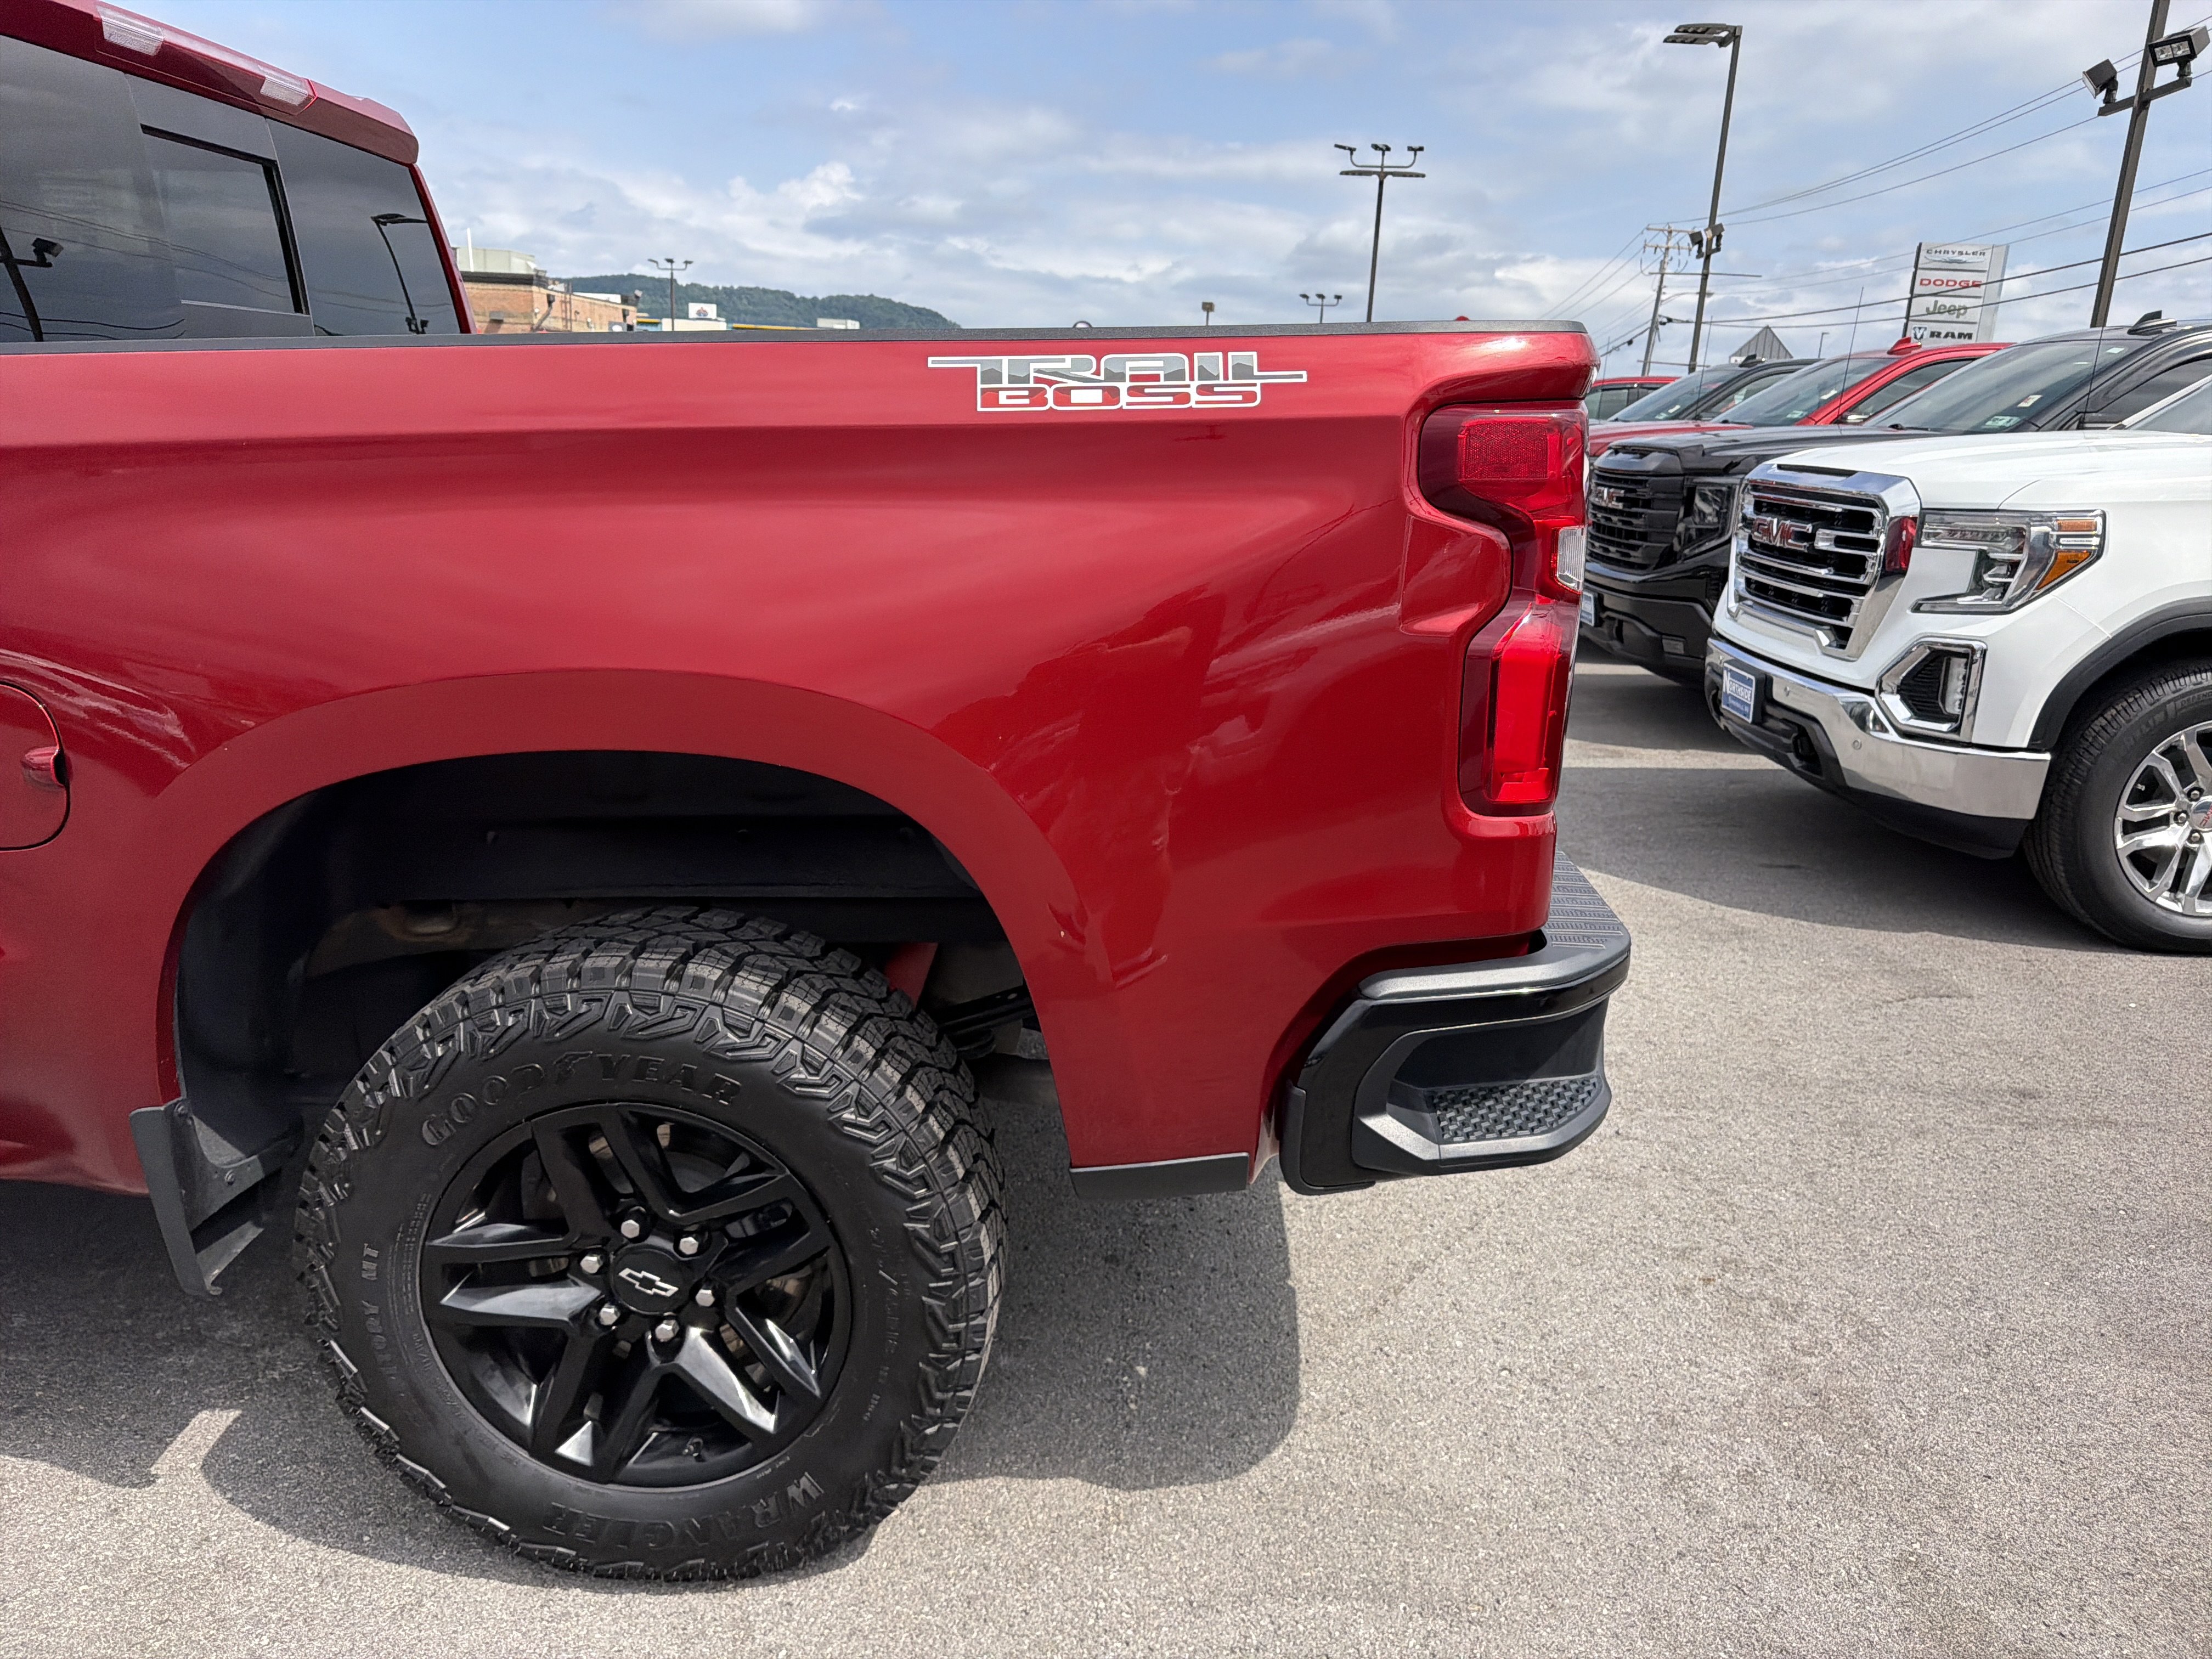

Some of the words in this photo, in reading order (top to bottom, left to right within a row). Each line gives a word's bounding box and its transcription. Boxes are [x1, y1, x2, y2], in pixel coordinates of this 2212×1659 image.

[1920, 278, 1982, 288] DODGE
[1926, 300, 1967, 318] Jeep
[1929, 331, 1973, 340] RAM
[928, 351, 1307, 384] TRAIL
[977, 382, 1261, 411] BOSS
[1593, 486, 1625, 509] GMC
[1752, 517, 1813, 552] GMC
[1723, 669, 1752, 701] NORTHSIDE
[543, 1471, 824, 1550] WRANGLER
